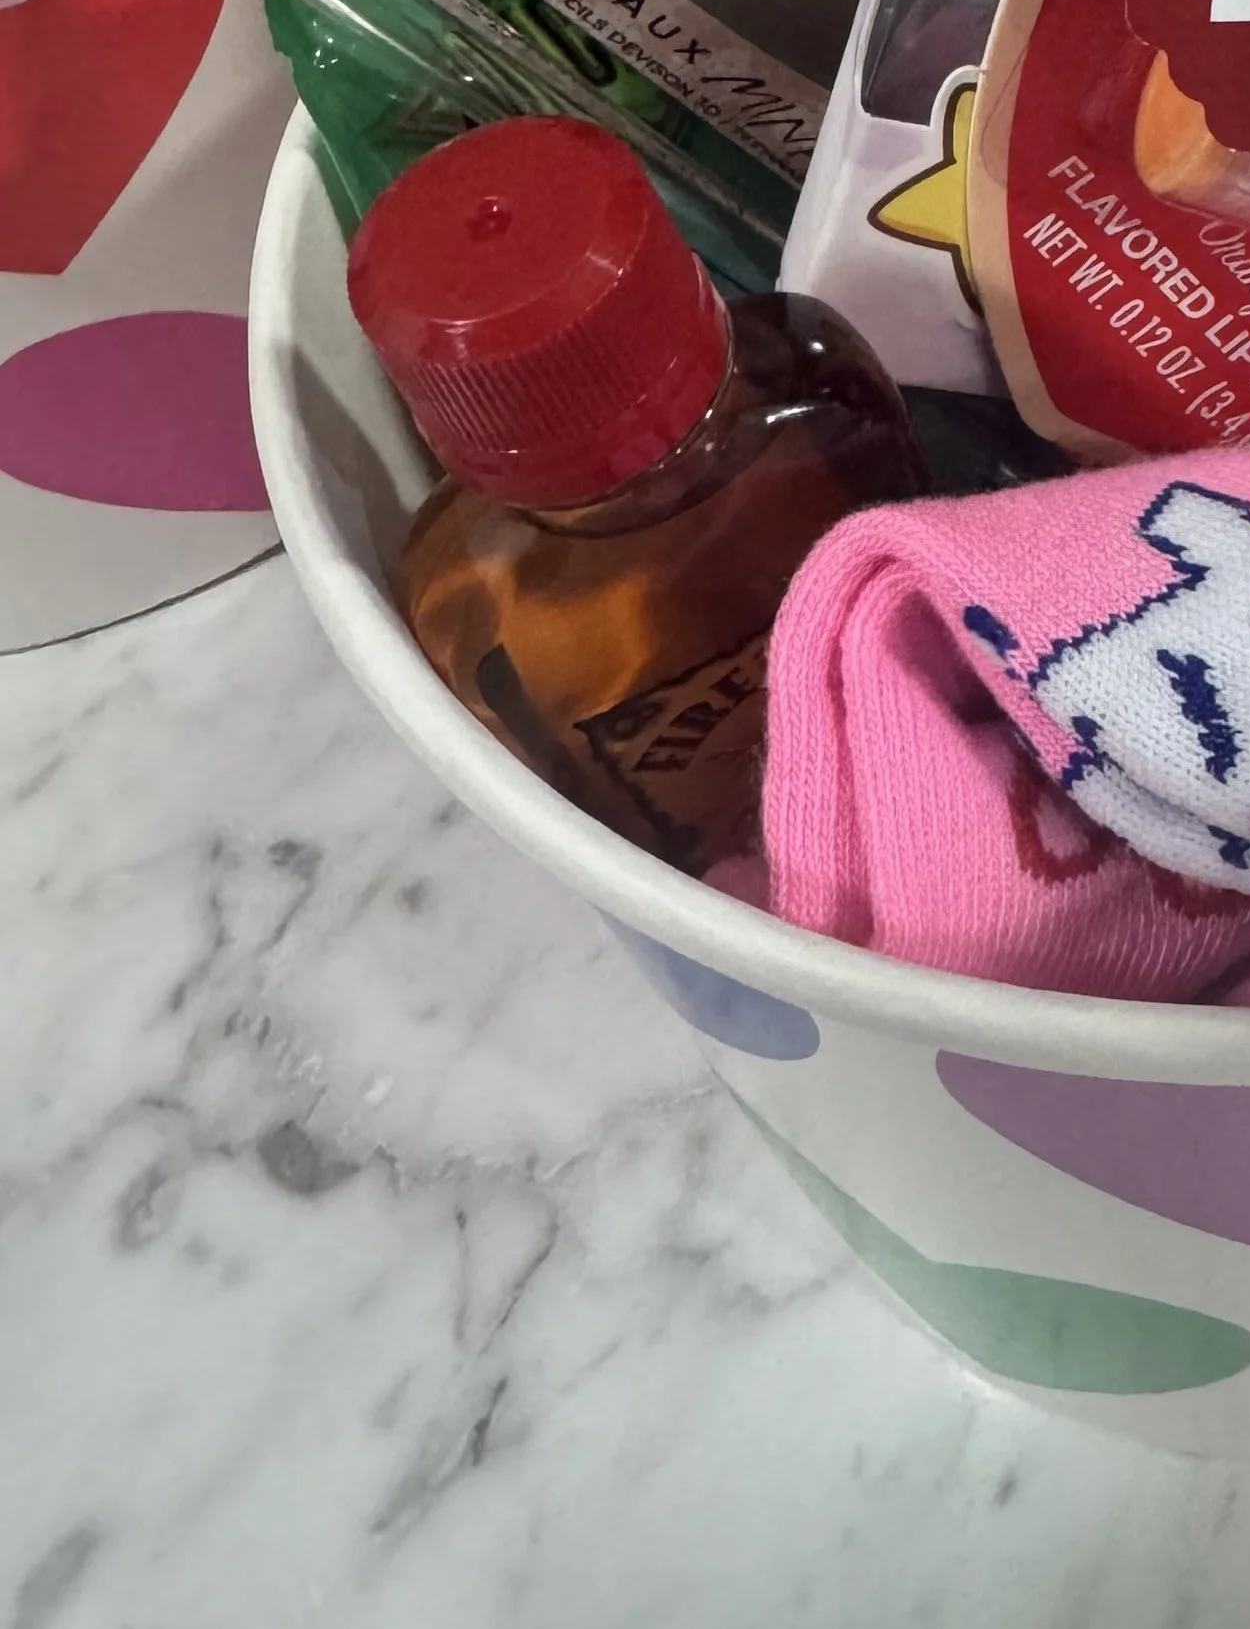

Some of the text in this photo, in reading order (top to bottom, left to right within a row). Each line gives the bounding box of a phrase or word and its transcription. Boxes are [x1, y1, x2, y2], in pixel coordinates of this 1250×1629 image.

[1022, 211, 1089, 267] NET
[1068, 254, 1124, 311] WT.
[1109, 298, 1174, 358] 0.12
[1155, 343, 1207, 395] OZ.
[1047, 154, 1216, 320] FLAVORED
